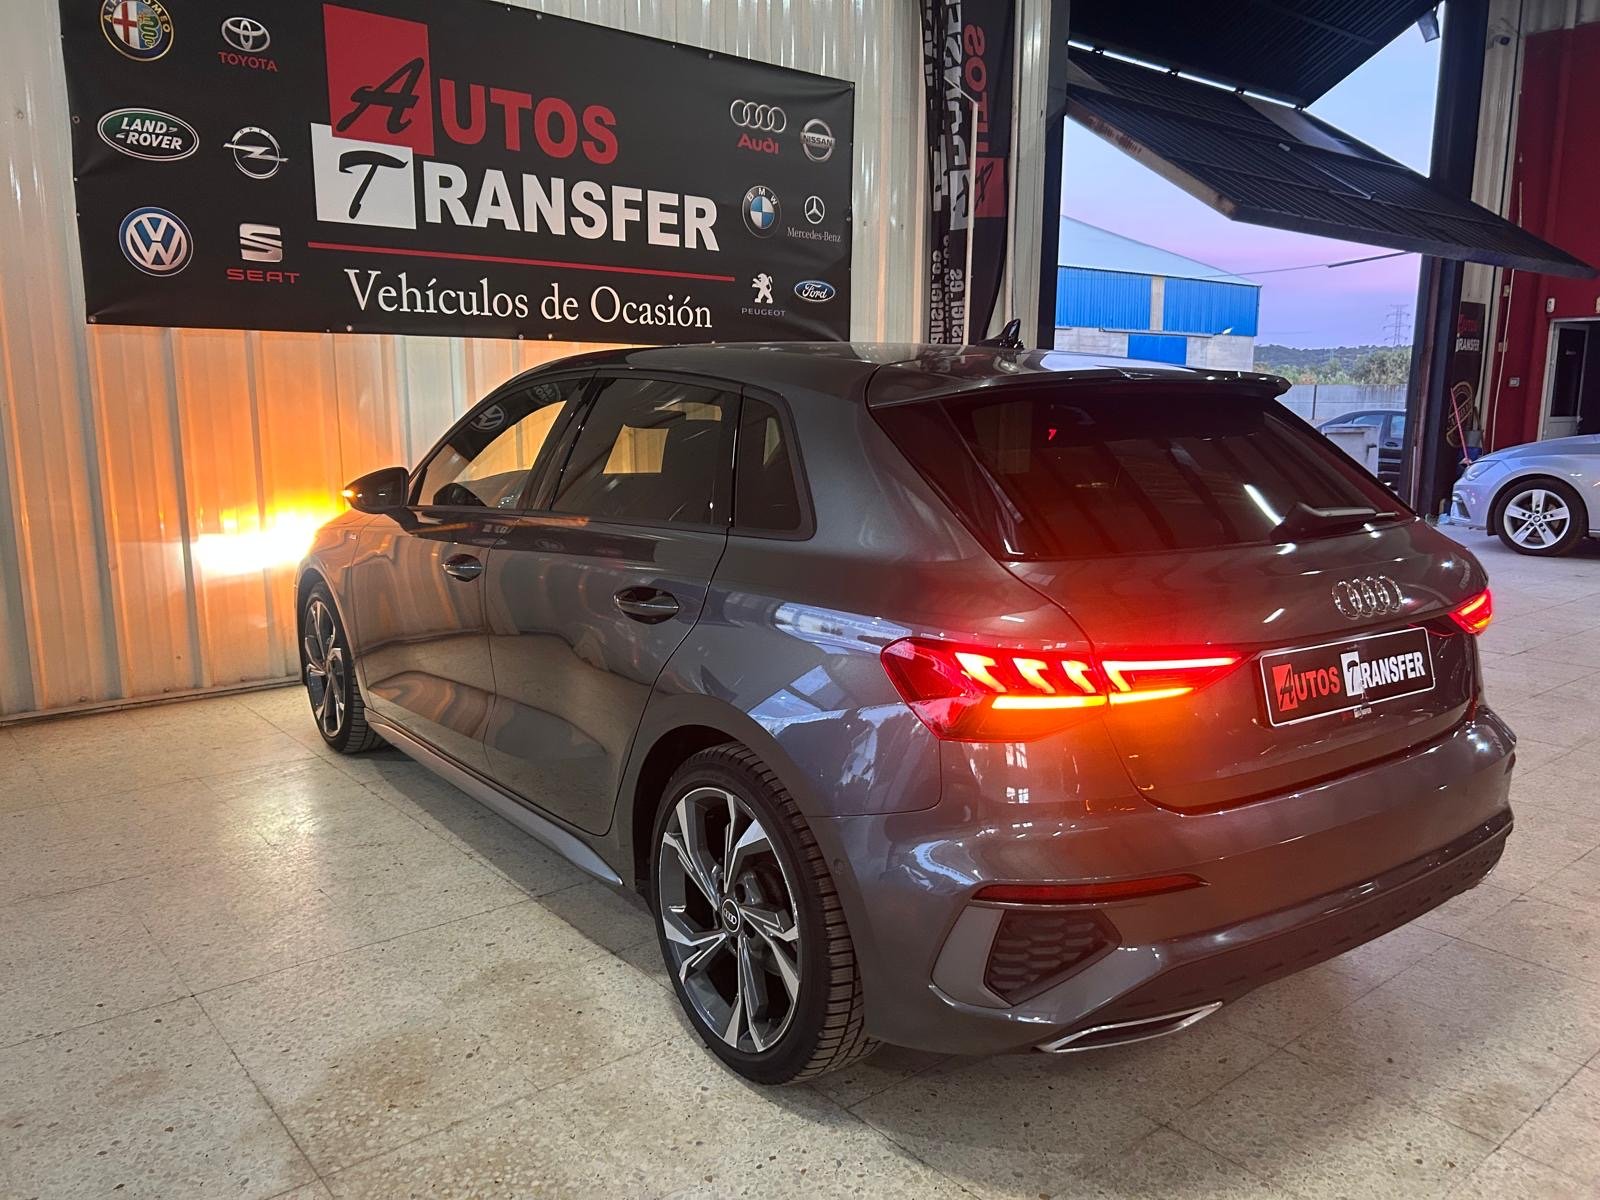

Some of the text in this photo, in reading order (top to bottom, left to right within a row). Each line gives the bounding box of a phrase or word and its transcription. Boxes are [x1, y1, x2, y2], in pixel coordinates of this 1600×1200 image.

[218, 51, 278, 72] TOYOTA
[336, 58, 619, 165] AUTOS
[121, 117, 168, 134] LAND
[126, 133, 183, 151] ROVER
[737, 133, 780, 154] Audi
[803, 134, 833, 146] NISSAN
[338, 150, 720, 251] TRANSFER
[746, 187, 778, 205] BMW
[787, 227, 841, 243] Mercedes-Benz
[226, 268, 300, 284] SEAT
[343, 268, 713, 328] Vehículos de Ocasión
[801, 283, 828, 299] Ford
[741, 307, 786, 317] PEUGEOT
[1273, 651, 1426, 711] AUTOS TRANSFER
